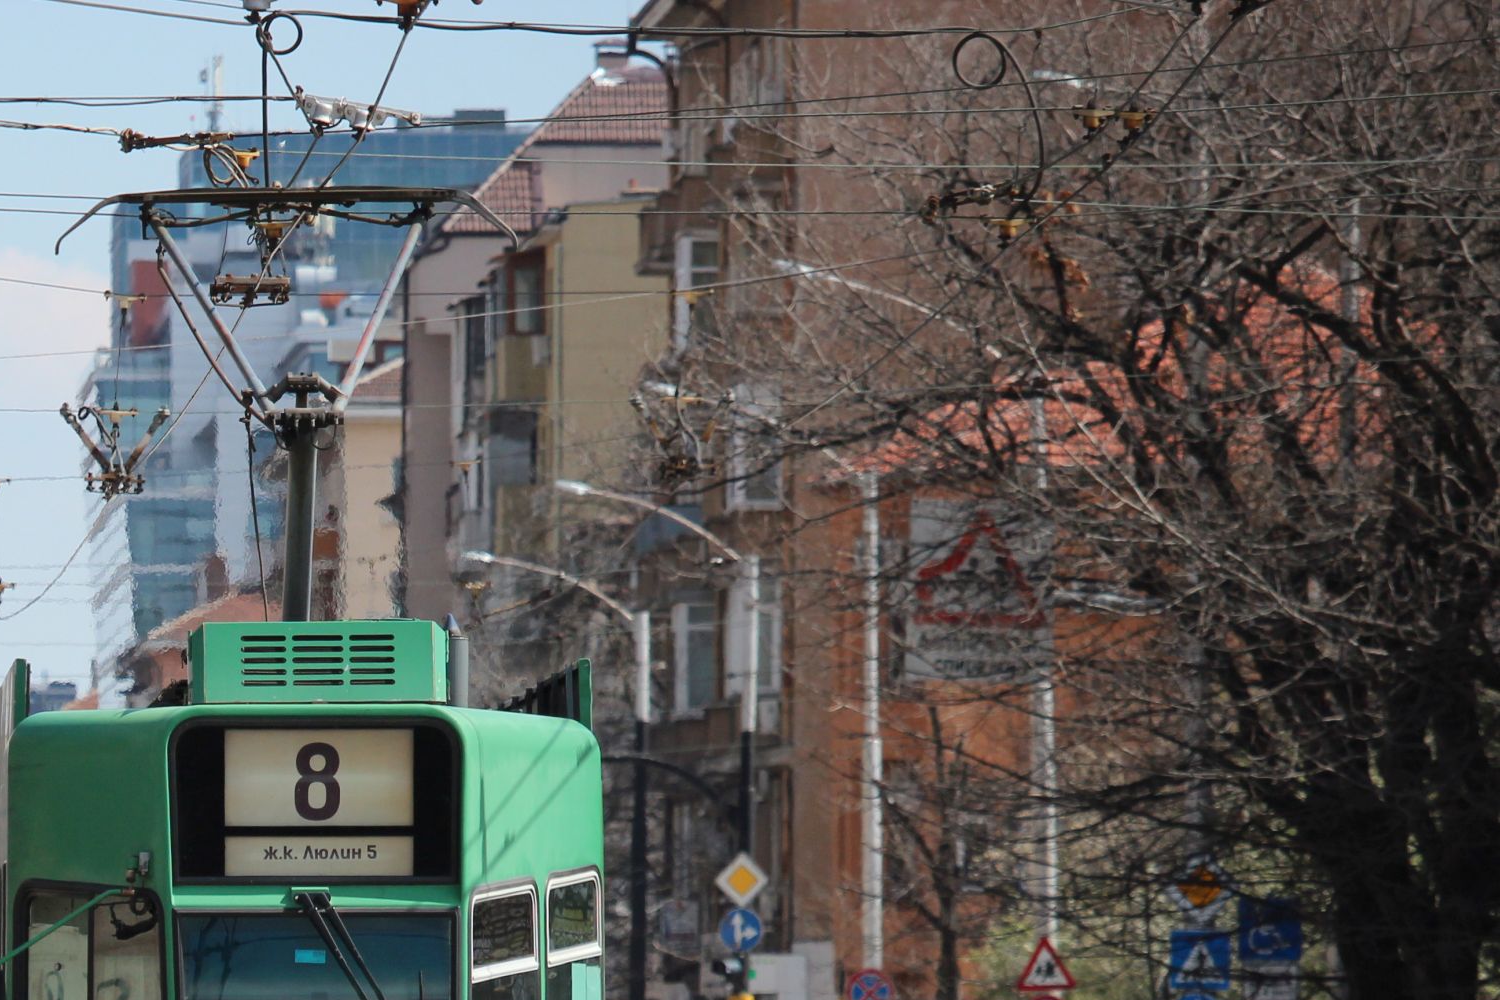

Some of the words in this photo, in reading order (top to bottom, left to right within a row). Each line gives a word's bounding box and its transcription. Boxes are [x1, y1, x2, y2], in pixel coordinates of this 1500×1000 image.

[295, 742, 341, 821] 8
[263, 846, 298, 860] ж.к.
[303, 845, 362, 860] Люлин
[367, 845, 377, 860] 5
